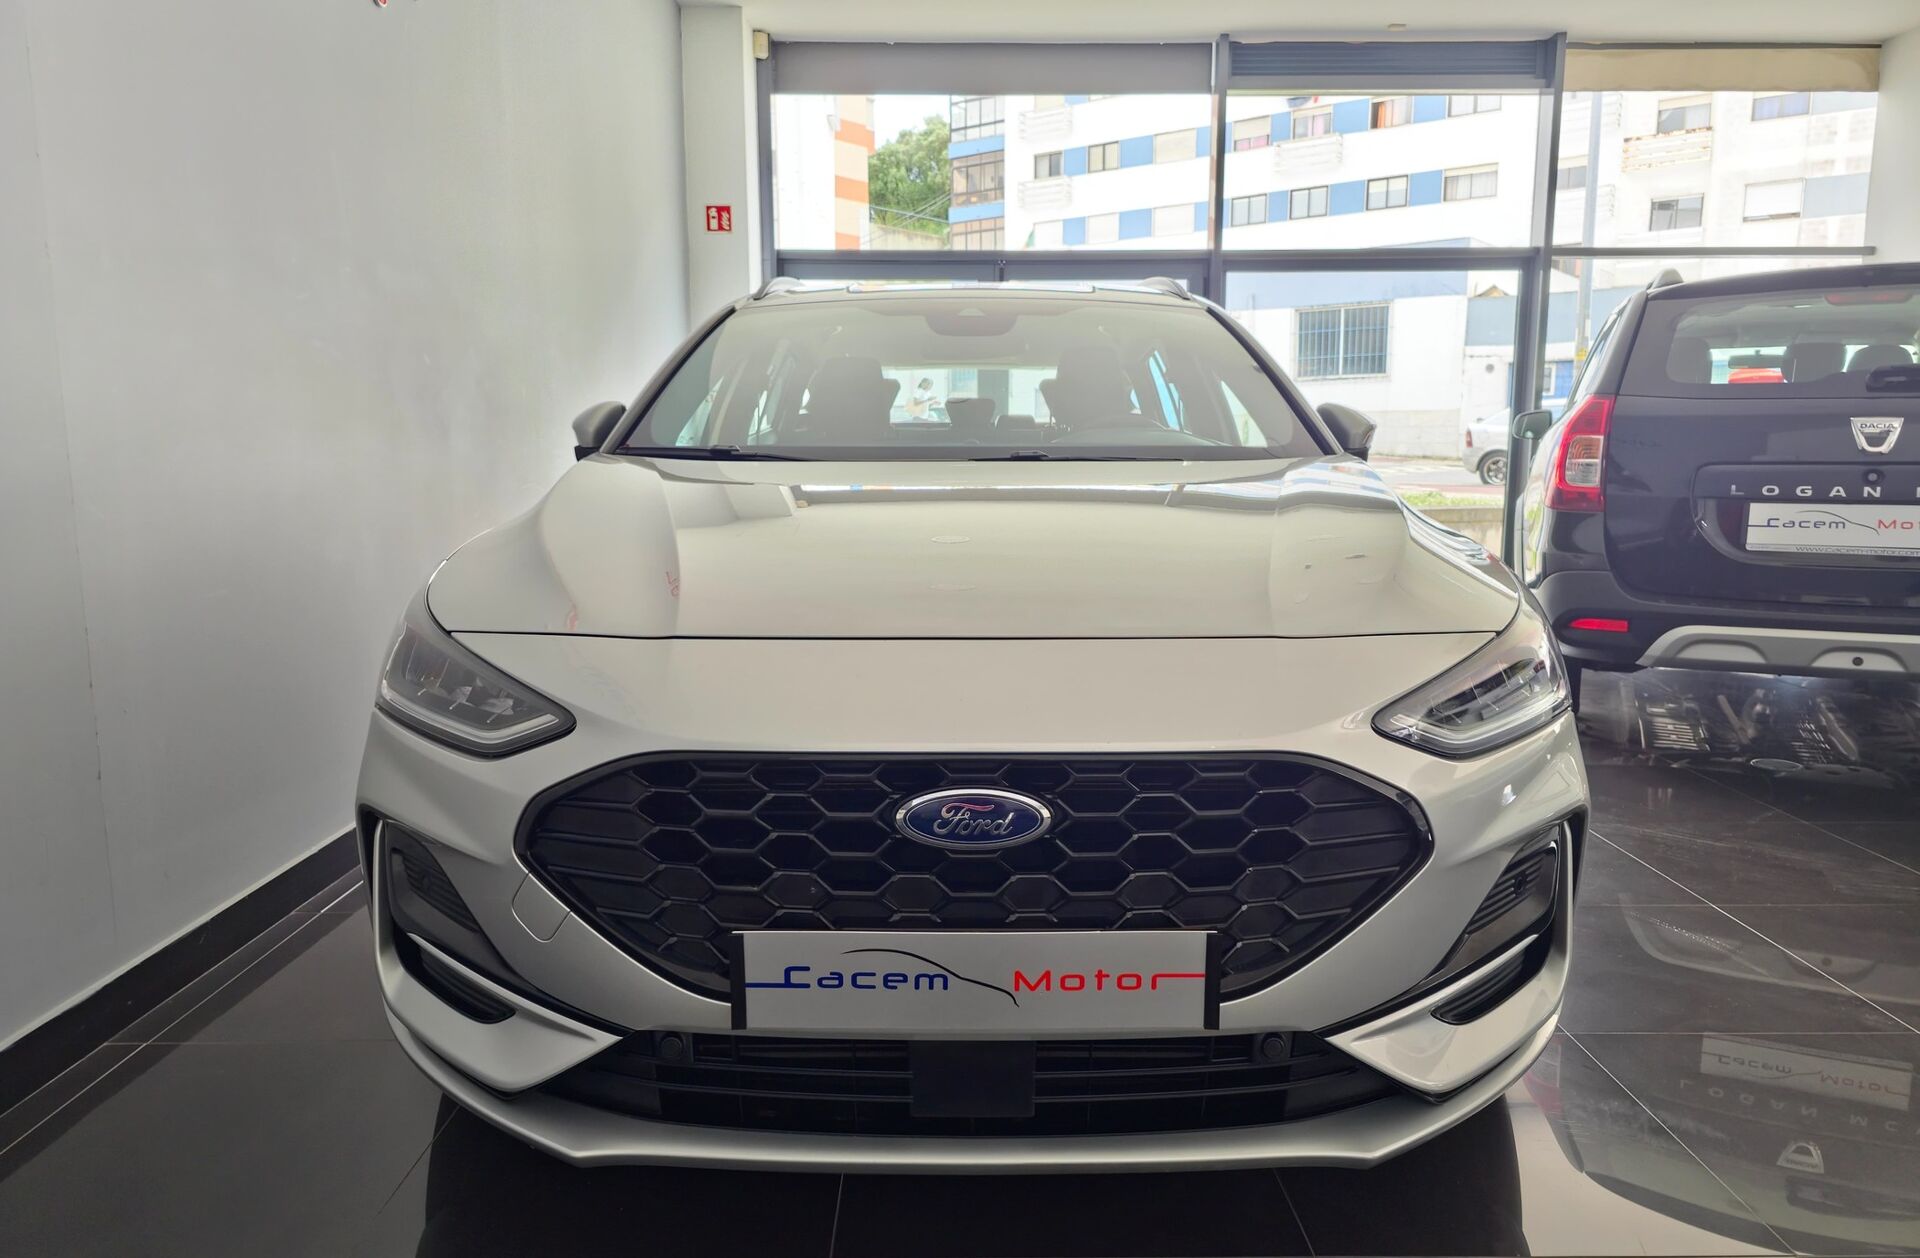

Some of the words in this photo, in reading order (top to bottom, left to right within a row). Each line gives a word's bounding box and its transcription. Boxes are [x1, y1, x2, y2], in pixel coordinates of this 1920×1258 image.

[1730, 484, 1881, 498] LOGAN
[1762, 517, 1846, 530] Cacem
[1878, 519, 1920, 530] Mo
[933, 802, 1015, 836] Ford
[746, 965, 949, 992] Cacem
[1013, 969, 1205, 992] Motor
